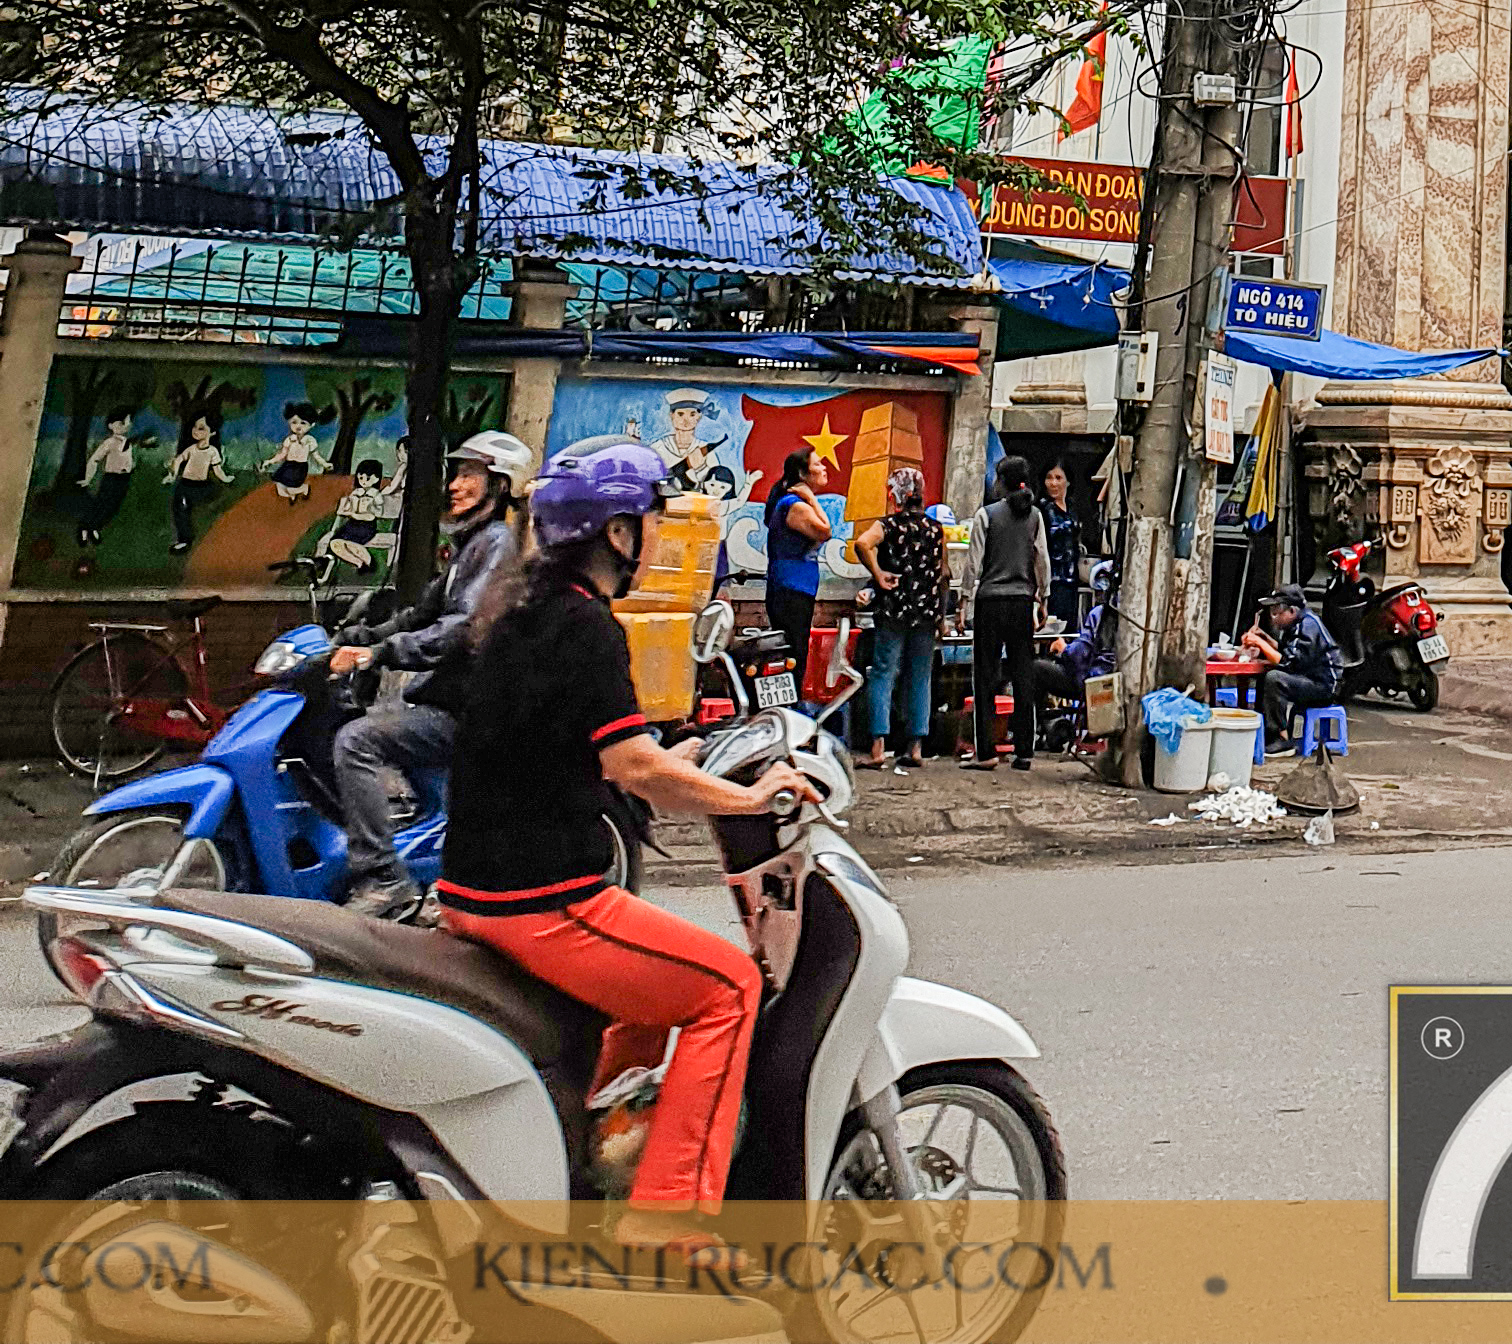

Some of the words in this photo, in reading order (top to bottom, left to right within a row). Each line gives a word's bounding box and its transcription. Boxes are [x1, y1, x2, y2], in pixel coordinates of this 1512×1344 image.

[1238, 286, 1272, 306] NGÕ
[1275, 293, 1304, 311] 414
[1234, 307, 1258, 322] TÔ
[1265, 311, 1309, 329] HIỆU
